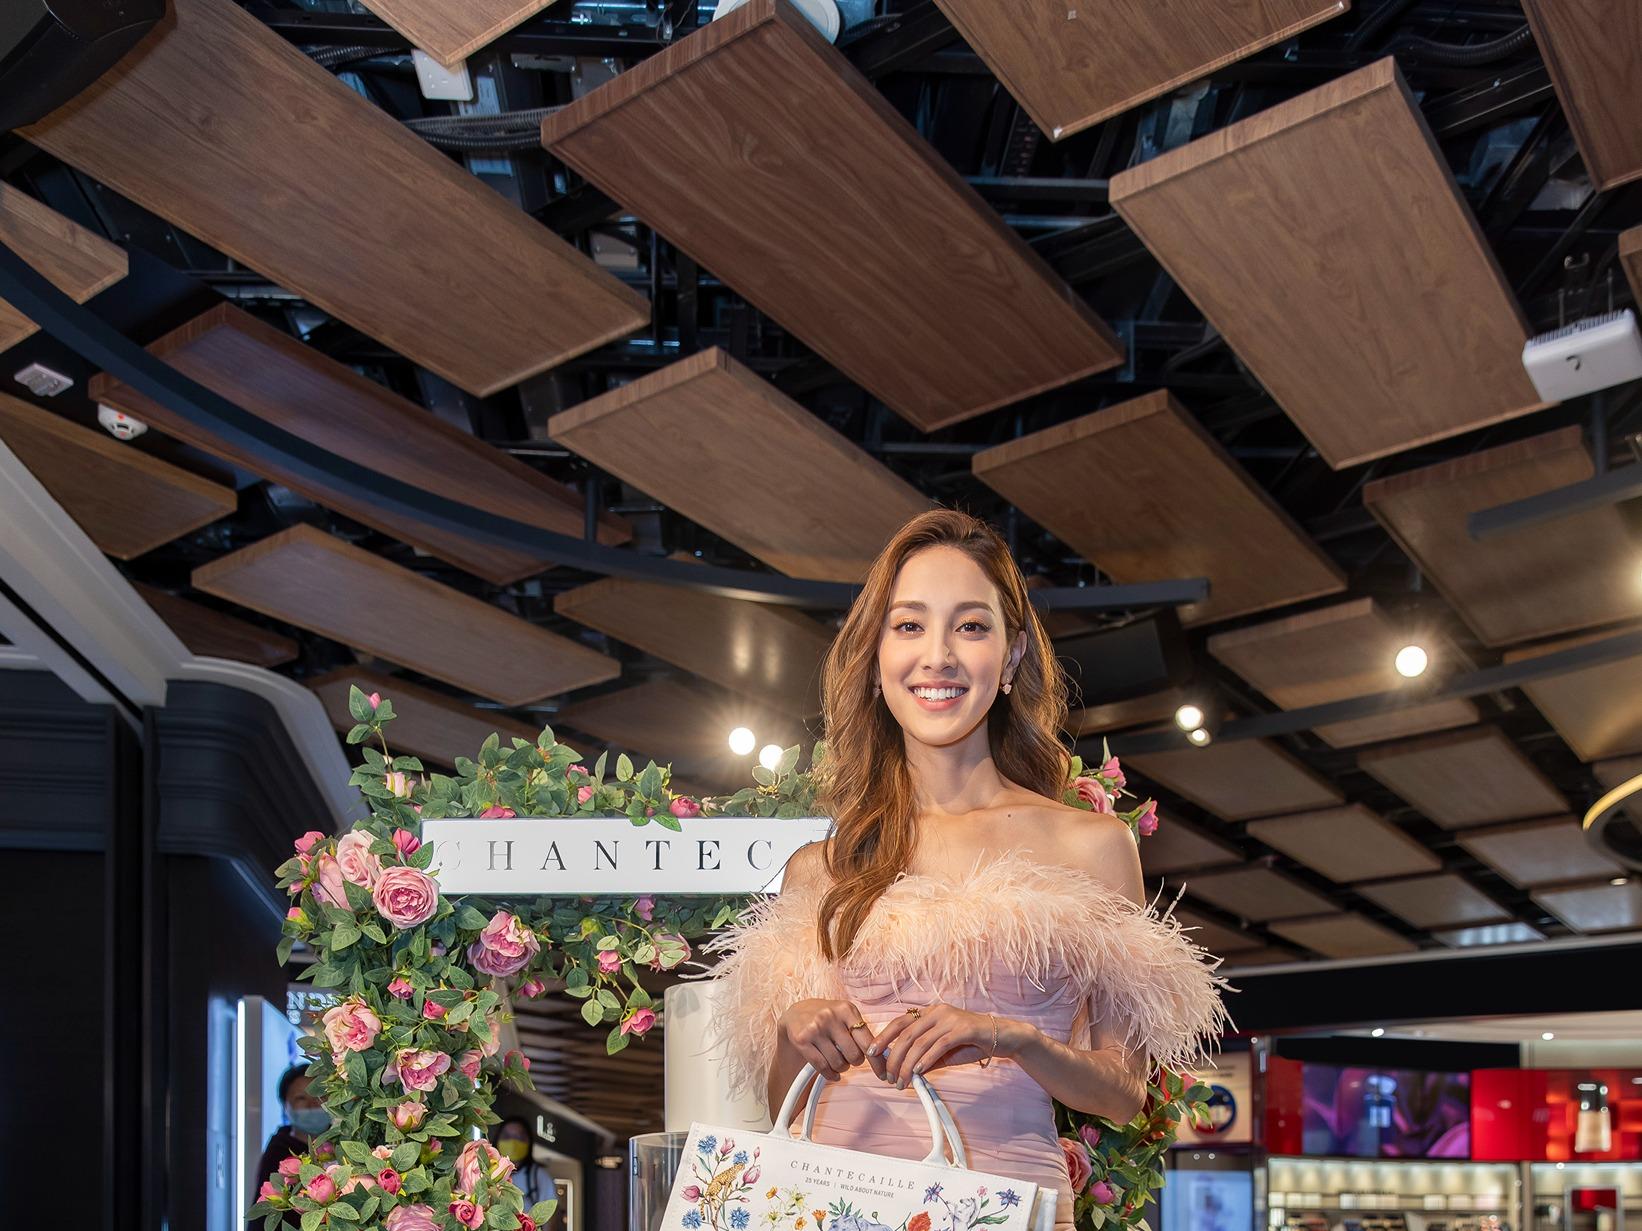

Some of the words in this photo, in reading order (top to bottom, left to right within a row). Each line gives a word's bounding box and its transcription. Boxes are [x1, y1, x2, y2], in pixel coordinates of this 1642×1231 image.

[789, 1159, 916, 1190] CHANTECAILLE
[804, 1176, 813, 1184] 25
[813, 1178, 831, 1188] YEARS
[840, 1183, 854, 1192] WILD
[854, 1186, 873, 1196] ABOUT
[873, 1189, 895, 1199] NATURE
